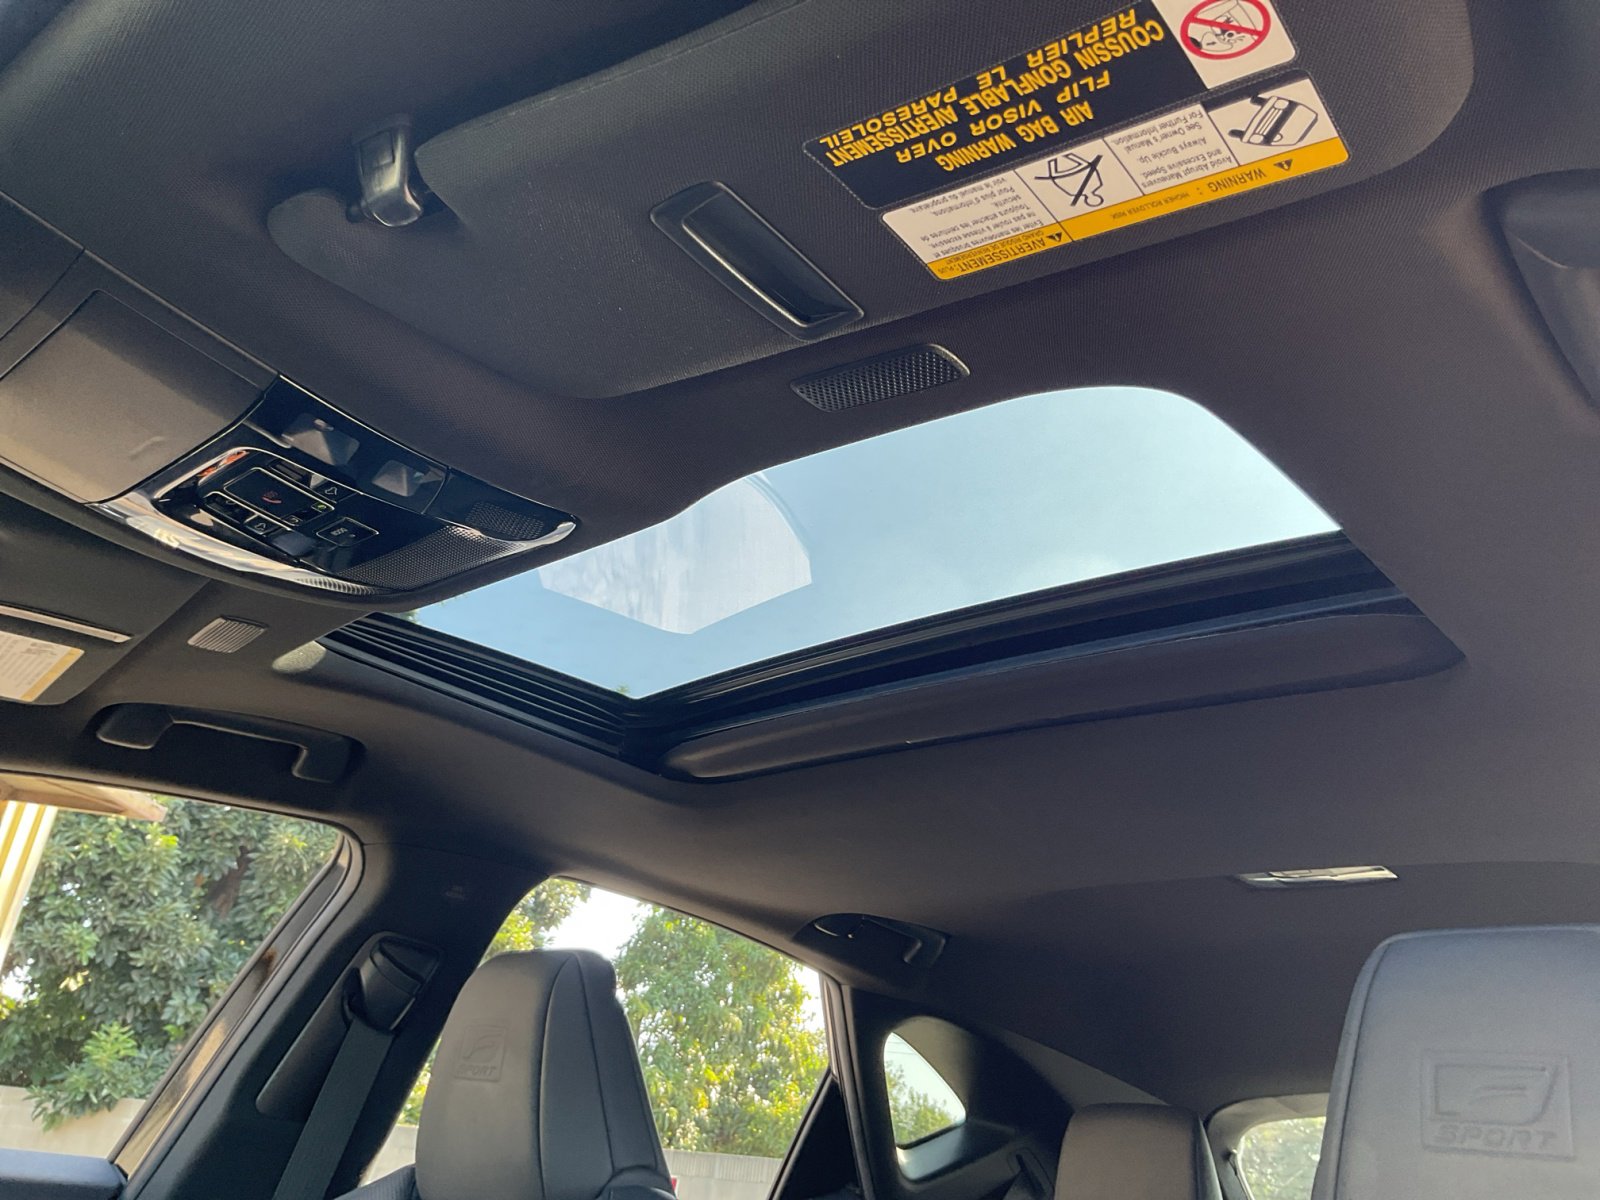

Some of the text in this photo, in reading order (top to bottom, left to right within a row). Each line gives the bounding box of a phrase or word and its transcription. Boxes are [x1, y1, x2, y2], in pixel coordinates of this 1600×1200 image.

[819, 8, 1137, 149] REPLIER LE PARESOLEIL
[825, 19, 1165, 167] COUSSIN GONFLABLE AVERTISSEMENT
[895, 69, 1111, 164] FLIP VISOR OVER
[1157, 114, 1188, 131] Further
[1186, 109, 1204, 121] For
[934, 100, 1094, 172] AIR BAG WARNING
[1184, 121, 1202, 133] See
[1123, 137, 1154, 153] Manual
[1176, 134, 1208, 152] Always
[1150, 146, 1178, 160] Buckle
[1166, 153, 1207, 171] Excessive
[1205, 148, 1223, 159] and
[1140, 155, 1233, 189] Avoid Abrupt Maneuvers
[1205, 166, 1266, 193] WARNING
[1433, 1123, 1557, 1149] SPORT
